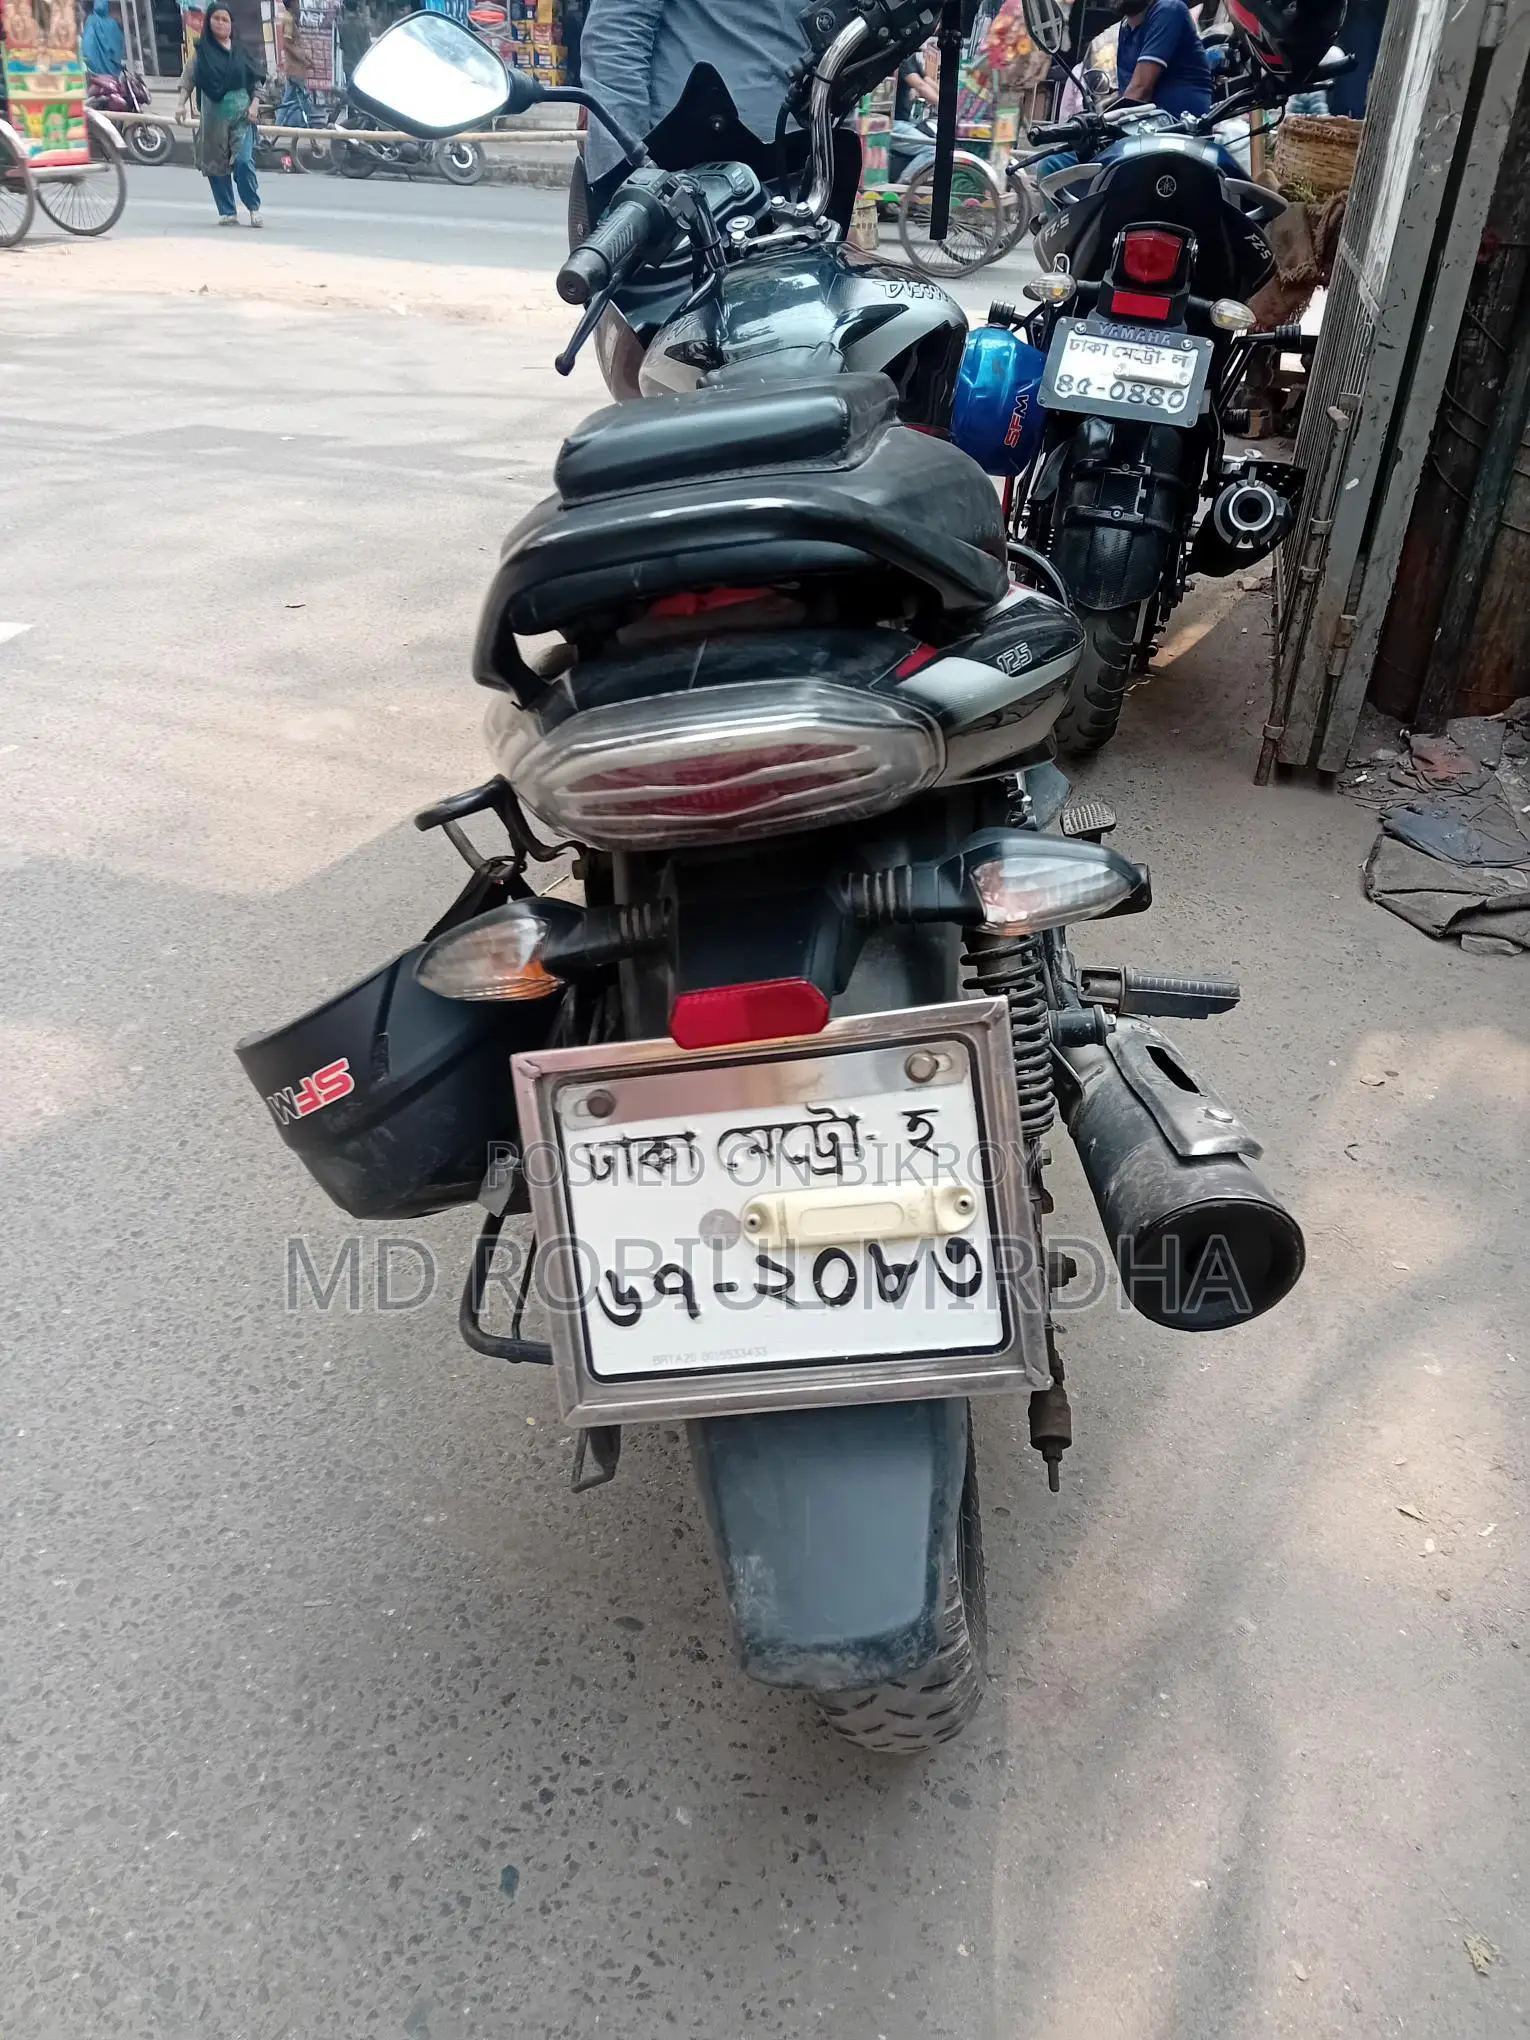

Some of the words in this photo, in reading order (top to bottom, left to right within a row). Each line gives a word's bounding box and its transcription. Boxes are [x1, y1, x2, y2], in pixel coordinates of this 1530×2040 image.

[1069, 338, 1108, 356] ঢাকা
[1171, 353, 1190, 368] ল
[1099, 322, 1171, 346] YAMAHA
[1056, 374, 1185, 409] ৪৫-০৪৪০
[1004, 394, 1029, 448] SFM
[996, 642, 1032, 676] 125
[266, 1057, 355, 1125] SFM
[584, 1129, 698, 1182] ঢাকা
[899, 1108, 940, 1156] হ
[596, 1236, 985, 1328] ৬৭-২০৮৩
